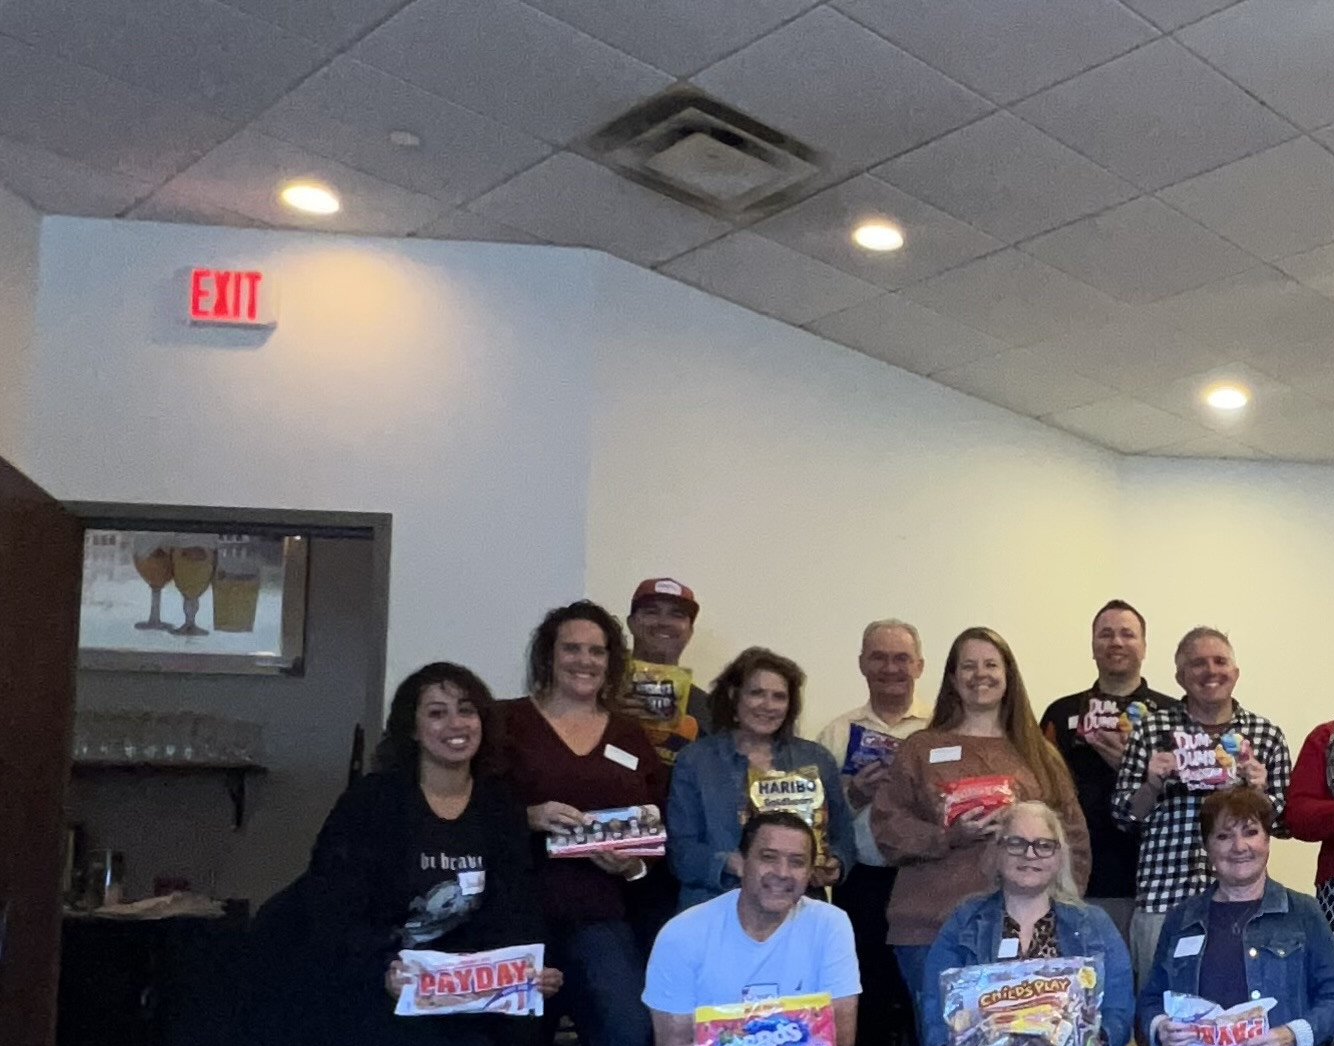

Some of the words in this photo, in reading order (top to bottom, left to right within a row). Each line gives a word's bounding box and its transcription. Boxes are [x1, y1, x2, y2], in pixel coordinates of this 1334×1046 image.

[191, 268, 262, 320] EXIT
[758, 780, 816, 795] HARIBO
[418, 959, 527, 995] PAYDAY
[1034, 978, 1070, 995] PLAY
